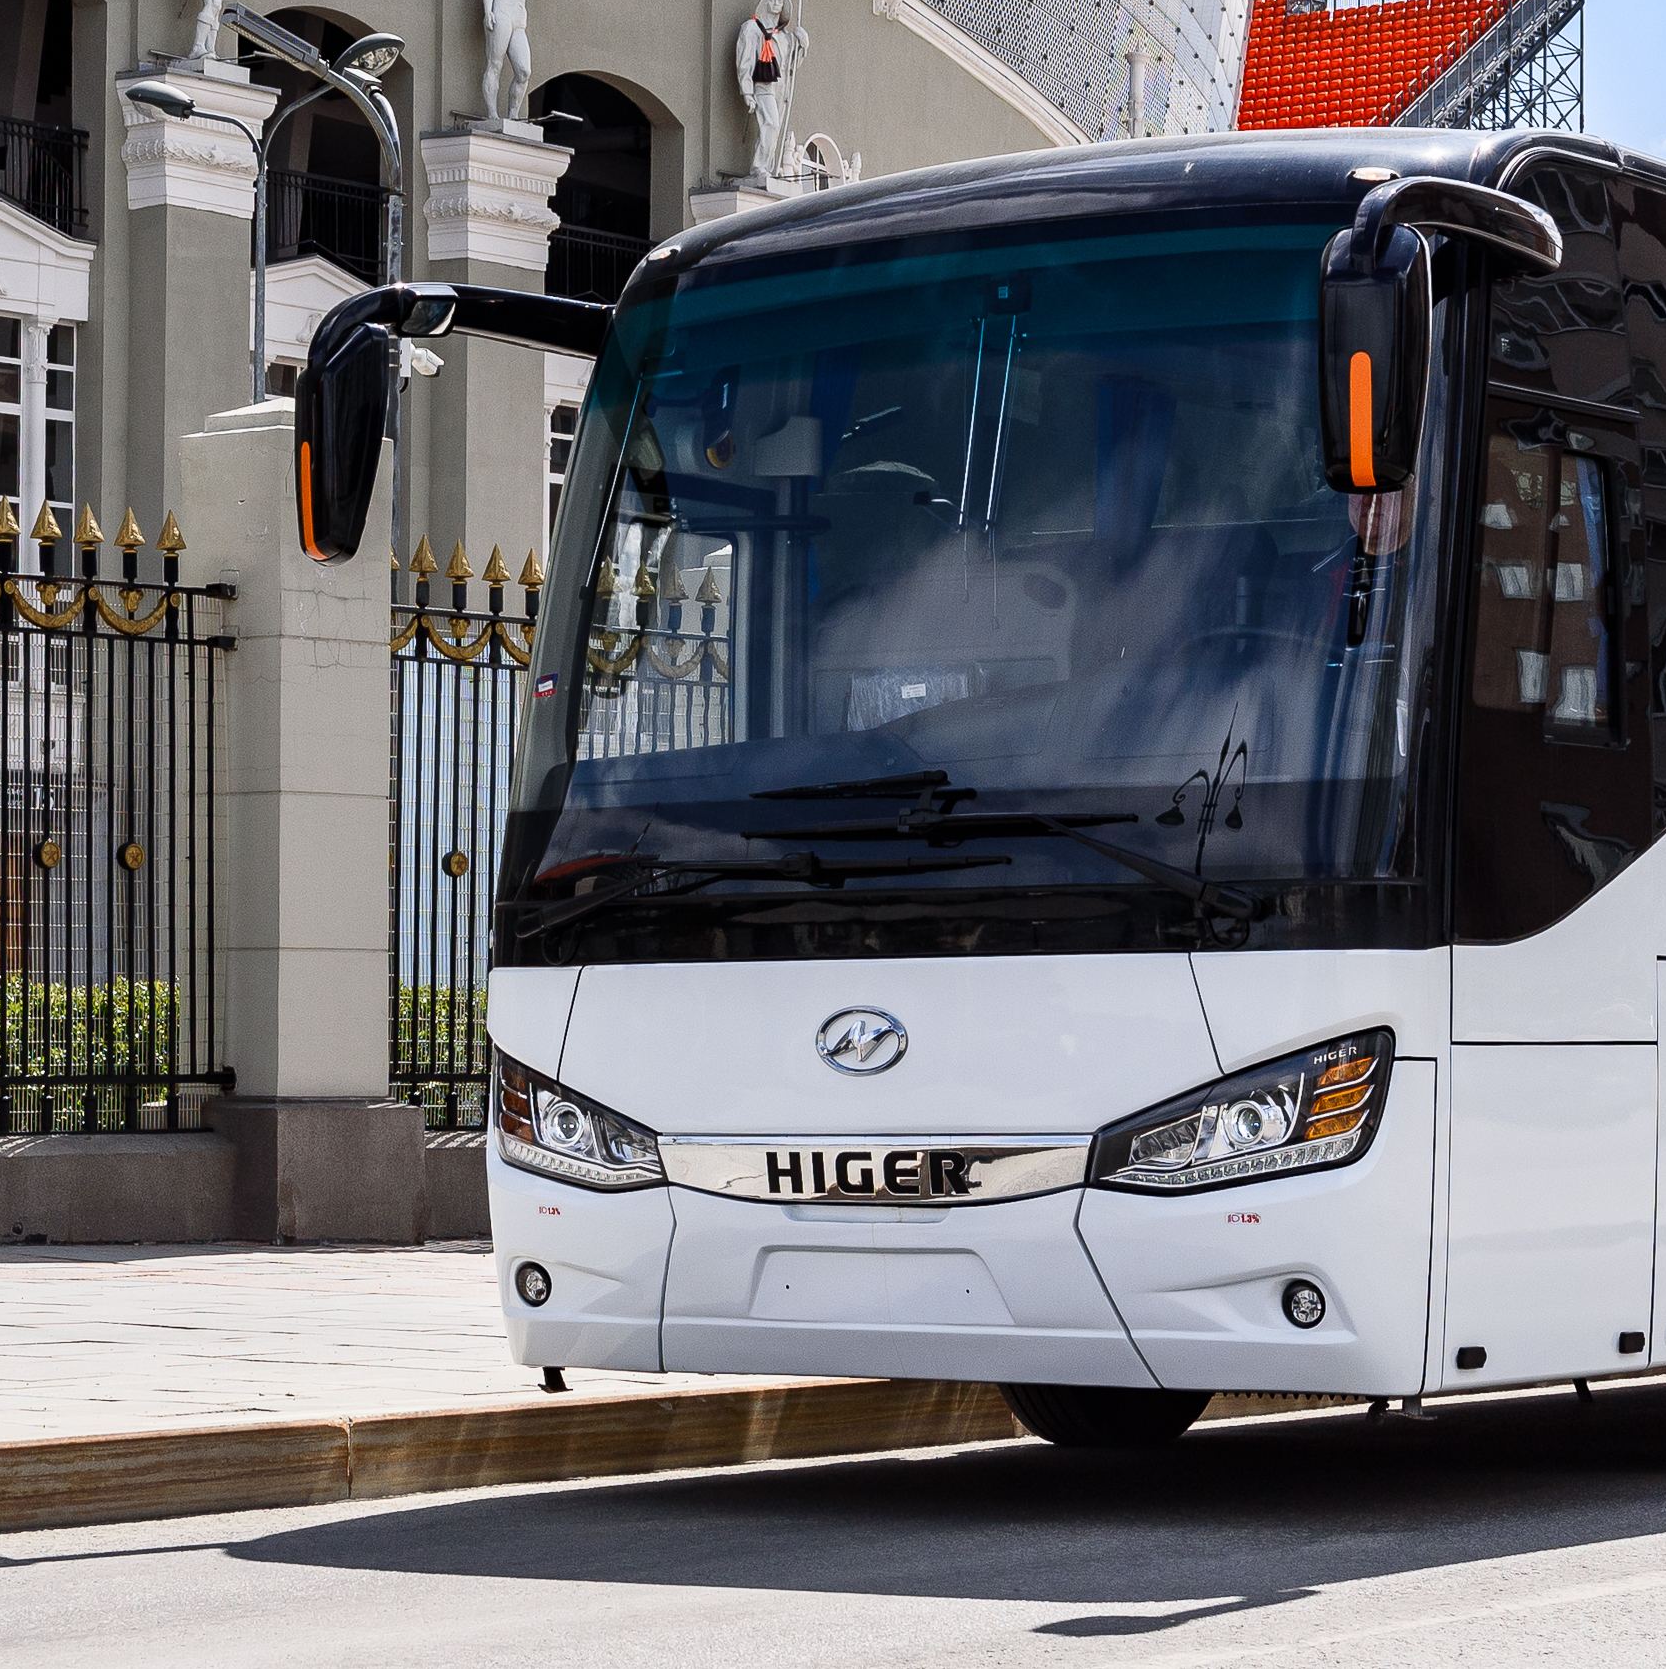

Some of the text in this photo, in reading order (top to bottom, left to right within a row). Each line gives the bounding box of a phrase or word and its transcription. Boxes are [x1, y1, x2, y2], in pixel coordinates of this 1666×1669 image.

[1314, 1046, 1357, 1065] HIGER
[765, 1151, 972, 1195] HIGER
[1241, 1213, 1260, 1224] 1.3%
